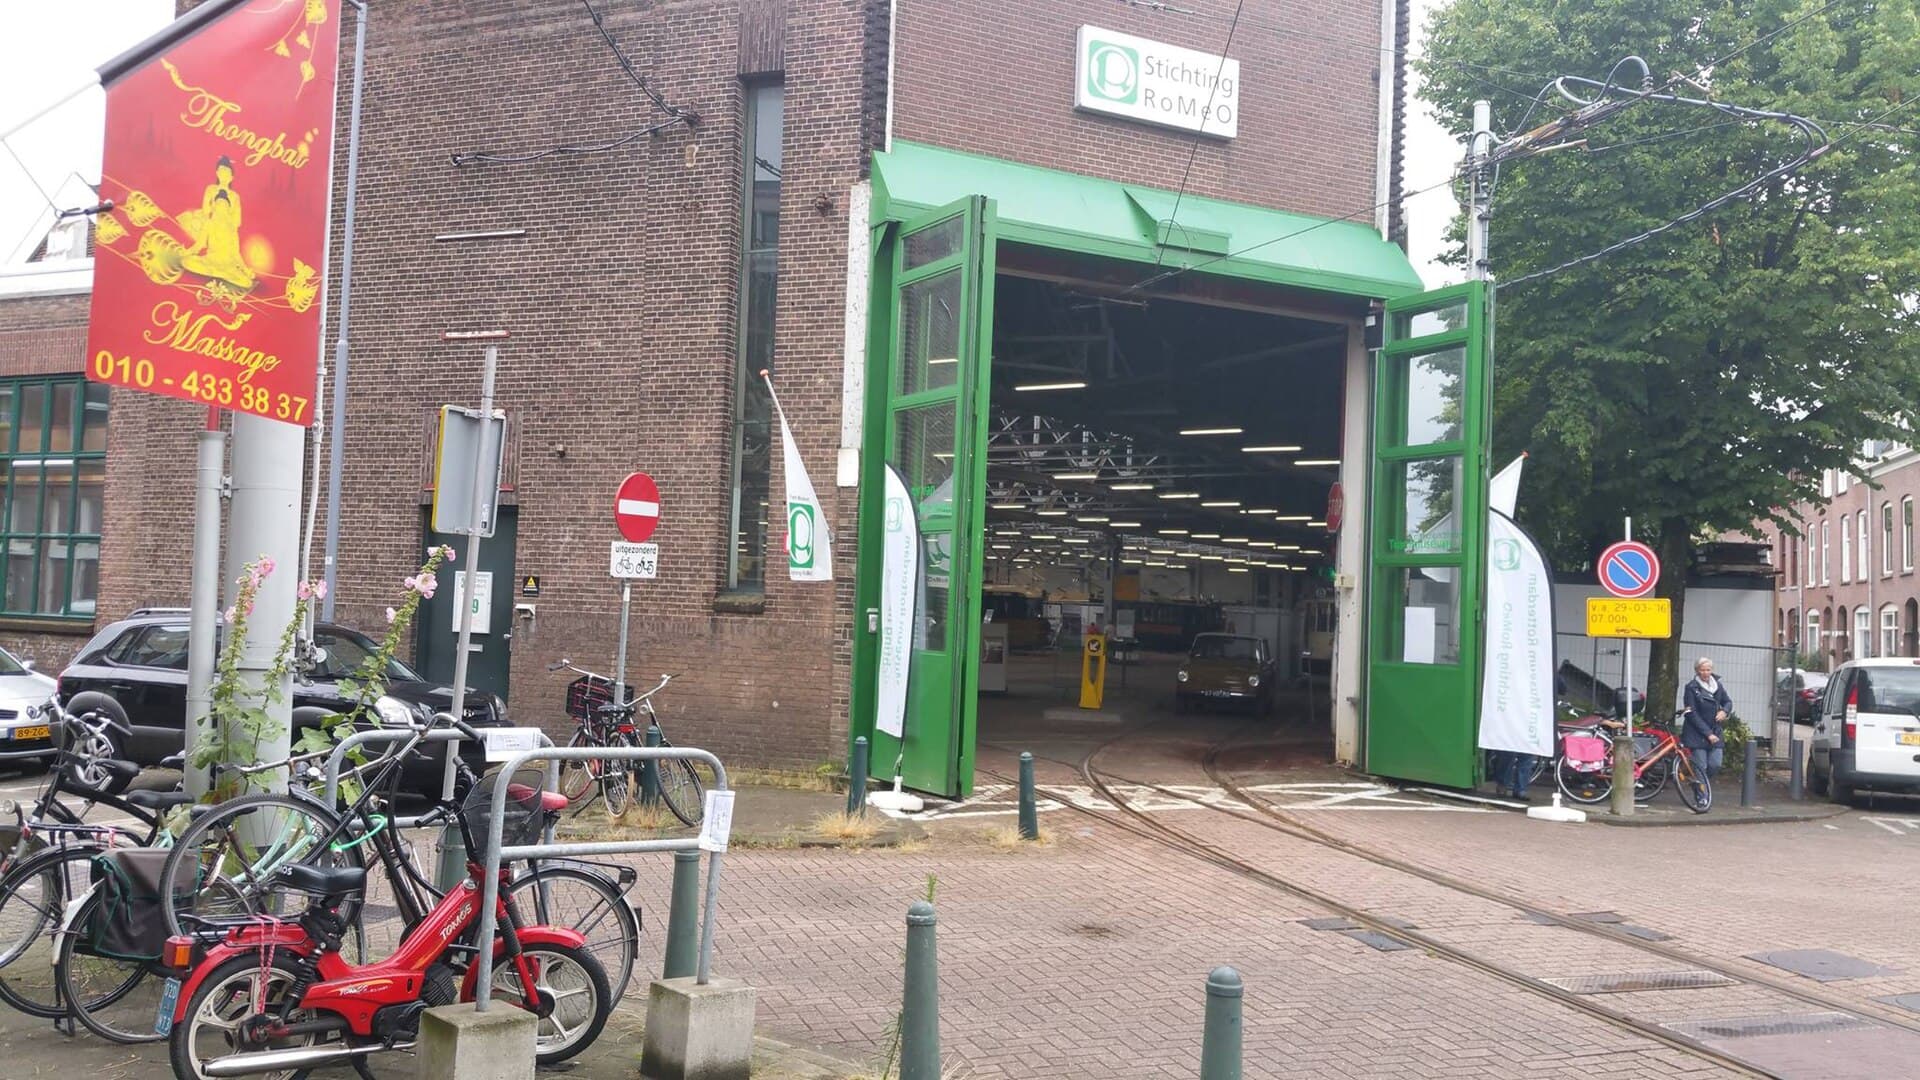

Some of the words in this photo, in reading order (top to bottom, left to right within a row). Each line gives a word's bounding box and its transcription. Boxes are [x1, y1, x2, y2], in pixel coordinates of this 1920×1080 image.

[1144, 55, 1233, 98] Stichting
[1144, 88, 1232, 124] RoMeO
[178, 90, 312, 169] Thongbai
[144, 301, 282, 384] Massage
[95, 350, 155, 388] 010
[181, 370, 233, 405] 433
[240, 383, 270, 414] 38
[276, 392, 308, 422] 37
[615, 545, 656, 555] uitgezonderd
[440, 903, 472, 940] TOMOS
